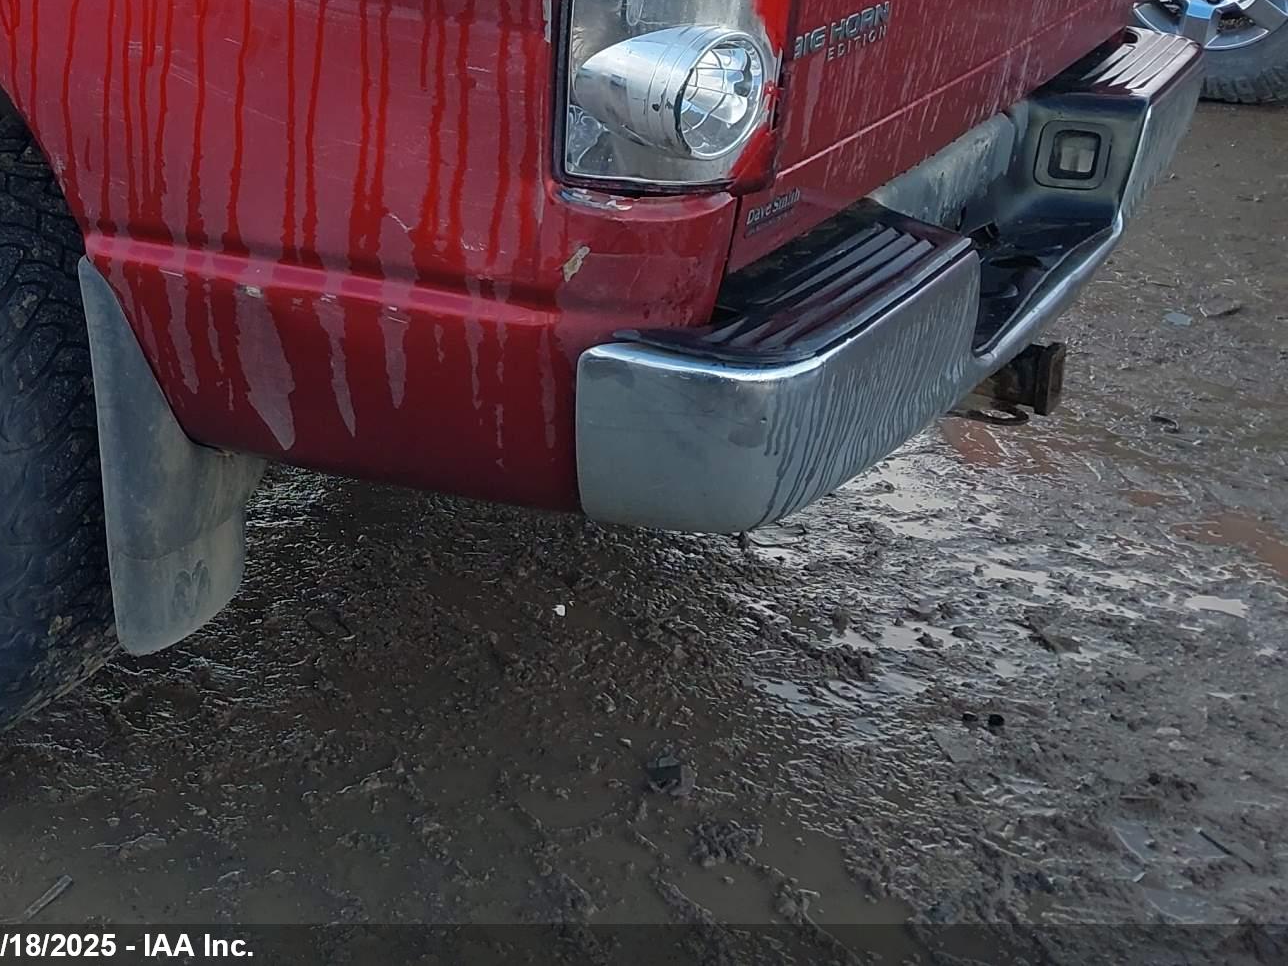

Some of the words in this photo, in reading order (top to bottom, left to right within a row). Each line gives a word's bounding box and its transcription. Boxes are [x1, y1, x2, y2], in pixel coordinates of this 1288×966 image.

[830, 1, 890, 45] HORN
[828, 26, 887, 62] EDITION
[746, 203, 772, 225] Dave
